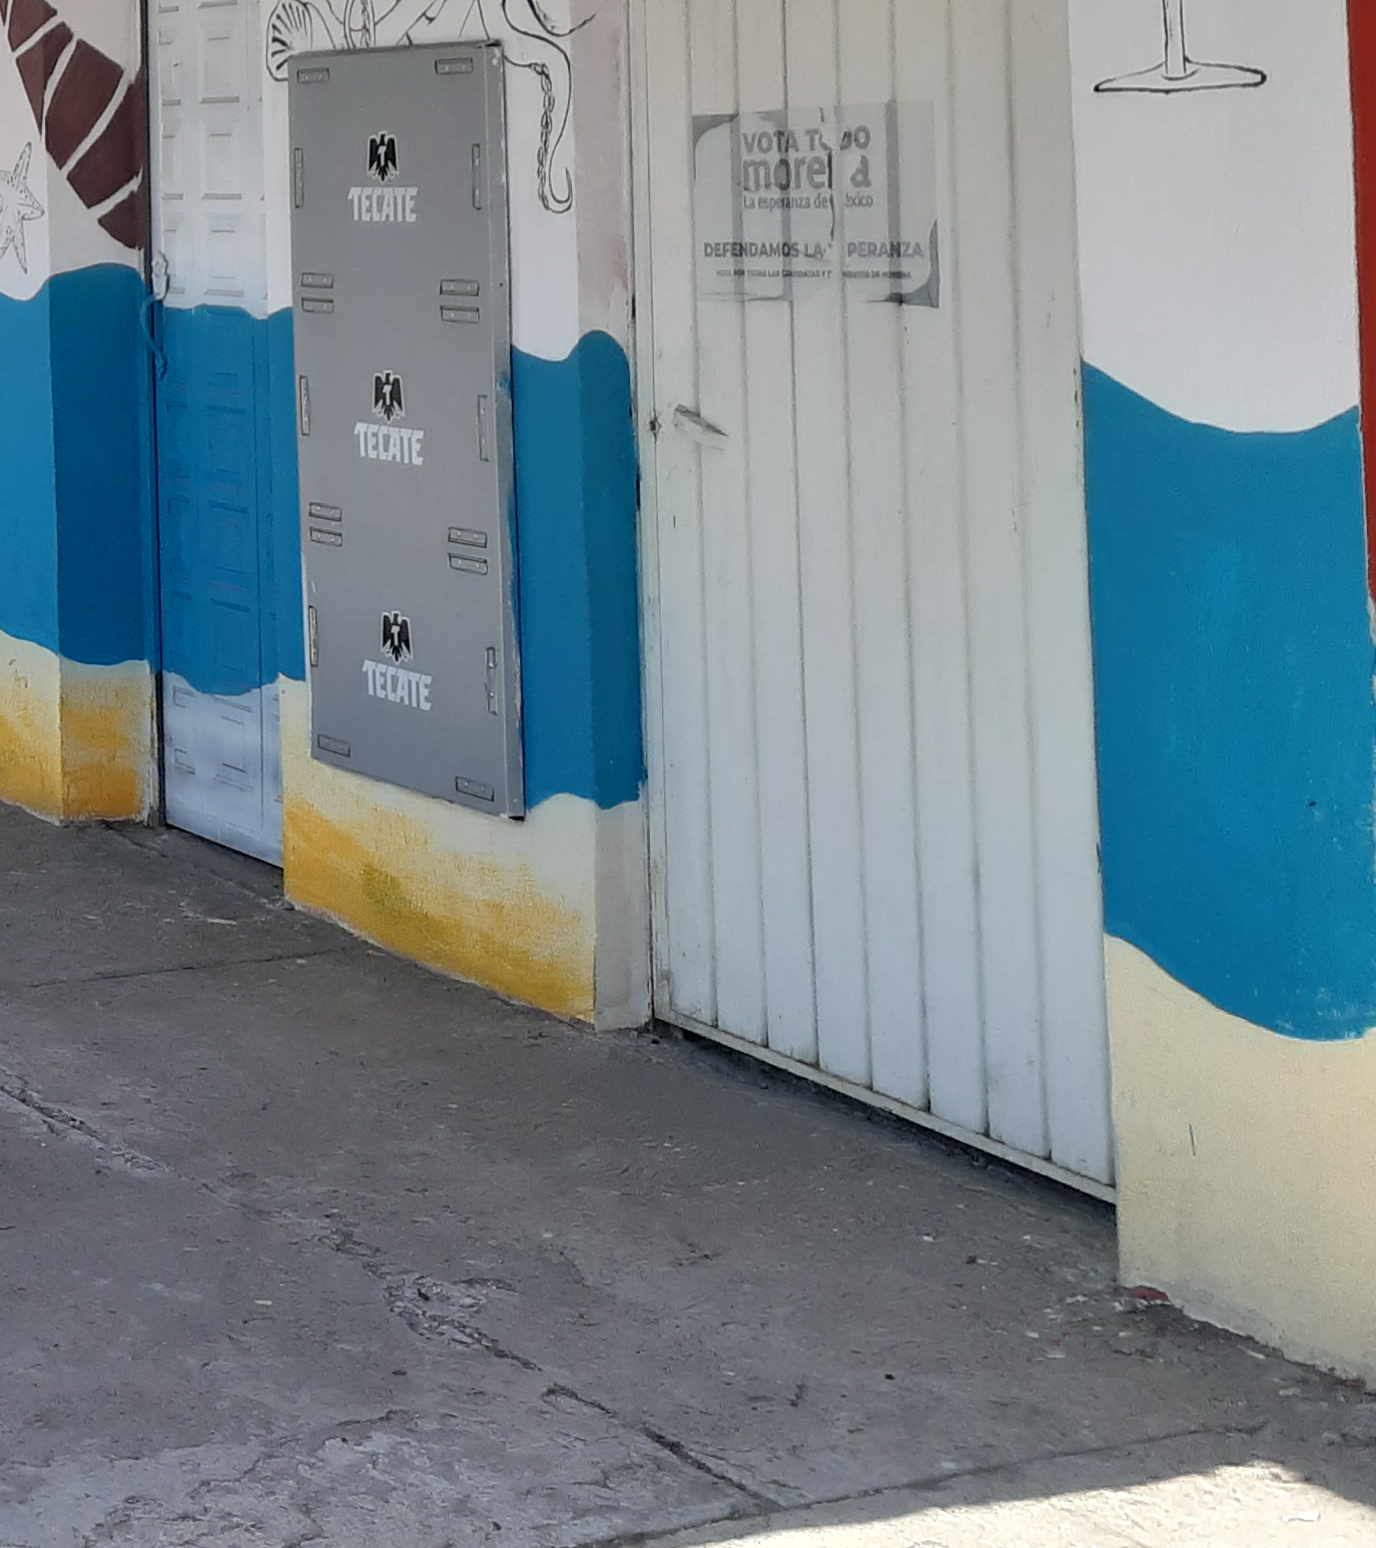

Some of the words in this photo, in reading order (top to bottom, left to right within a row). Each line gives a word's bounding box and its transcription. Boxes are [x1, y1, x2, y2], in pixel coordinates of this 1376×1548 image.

[742, 130, 799, 153] VOTA
[741, 154, 873, 192] morea
[347, 186, 419, 222] TECATE
[703, 241, 799, 260] DEFENDAMOS
[846, 240, 925, 260] PERANZA
[353, 421, 425, 465] TECATE
[361, 659, 433, 711] TECATE
